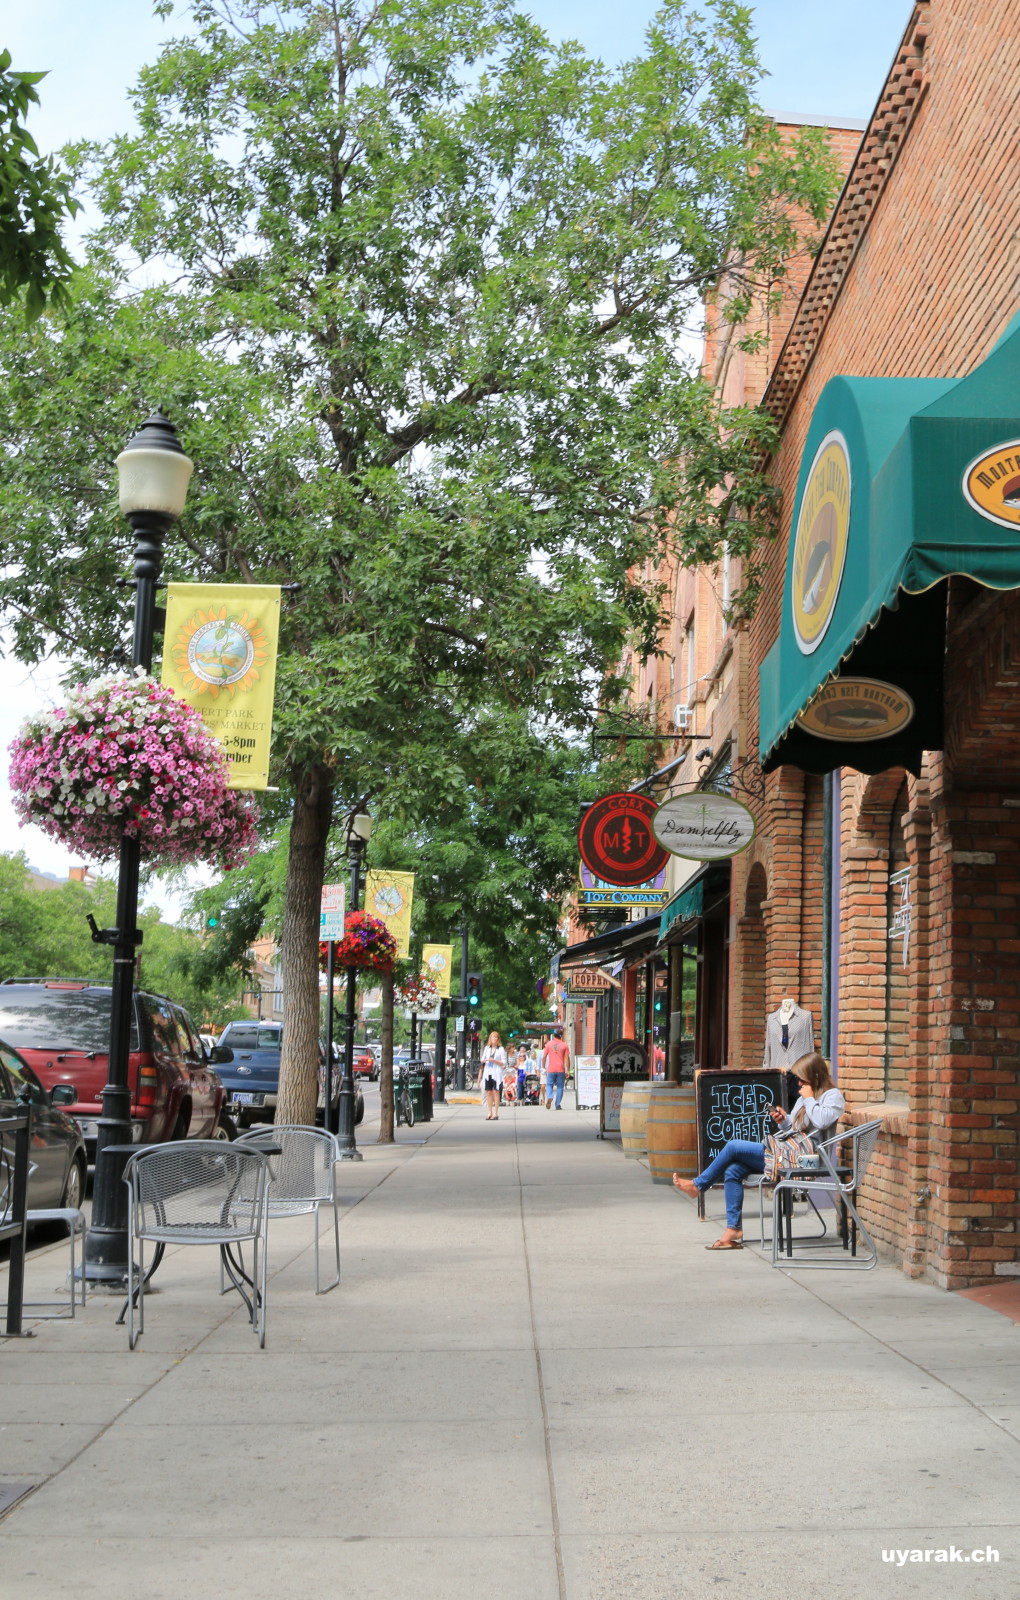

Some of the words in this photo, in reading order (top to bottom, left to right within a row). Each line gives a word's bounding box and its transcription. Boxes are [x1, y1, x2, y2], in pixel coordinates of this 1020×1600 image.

[226, 709, 254, 719] PARK
[221, 721, 266, 731] MARKET
[223, 735, 256, 749] 5-8pm
[608, 798, 646, 811] CORX
[661, 819, 744, 845] Damselfly
[603, 832, 619, 848] M
[634, 832, 647, 848] T
[584, 891, 607, 903] TOY
[611, 891, 663, 904] COMPANY
[711, 1083, 774, 1116] ICED
[706, 1115, 772, 1143] COFFEE
